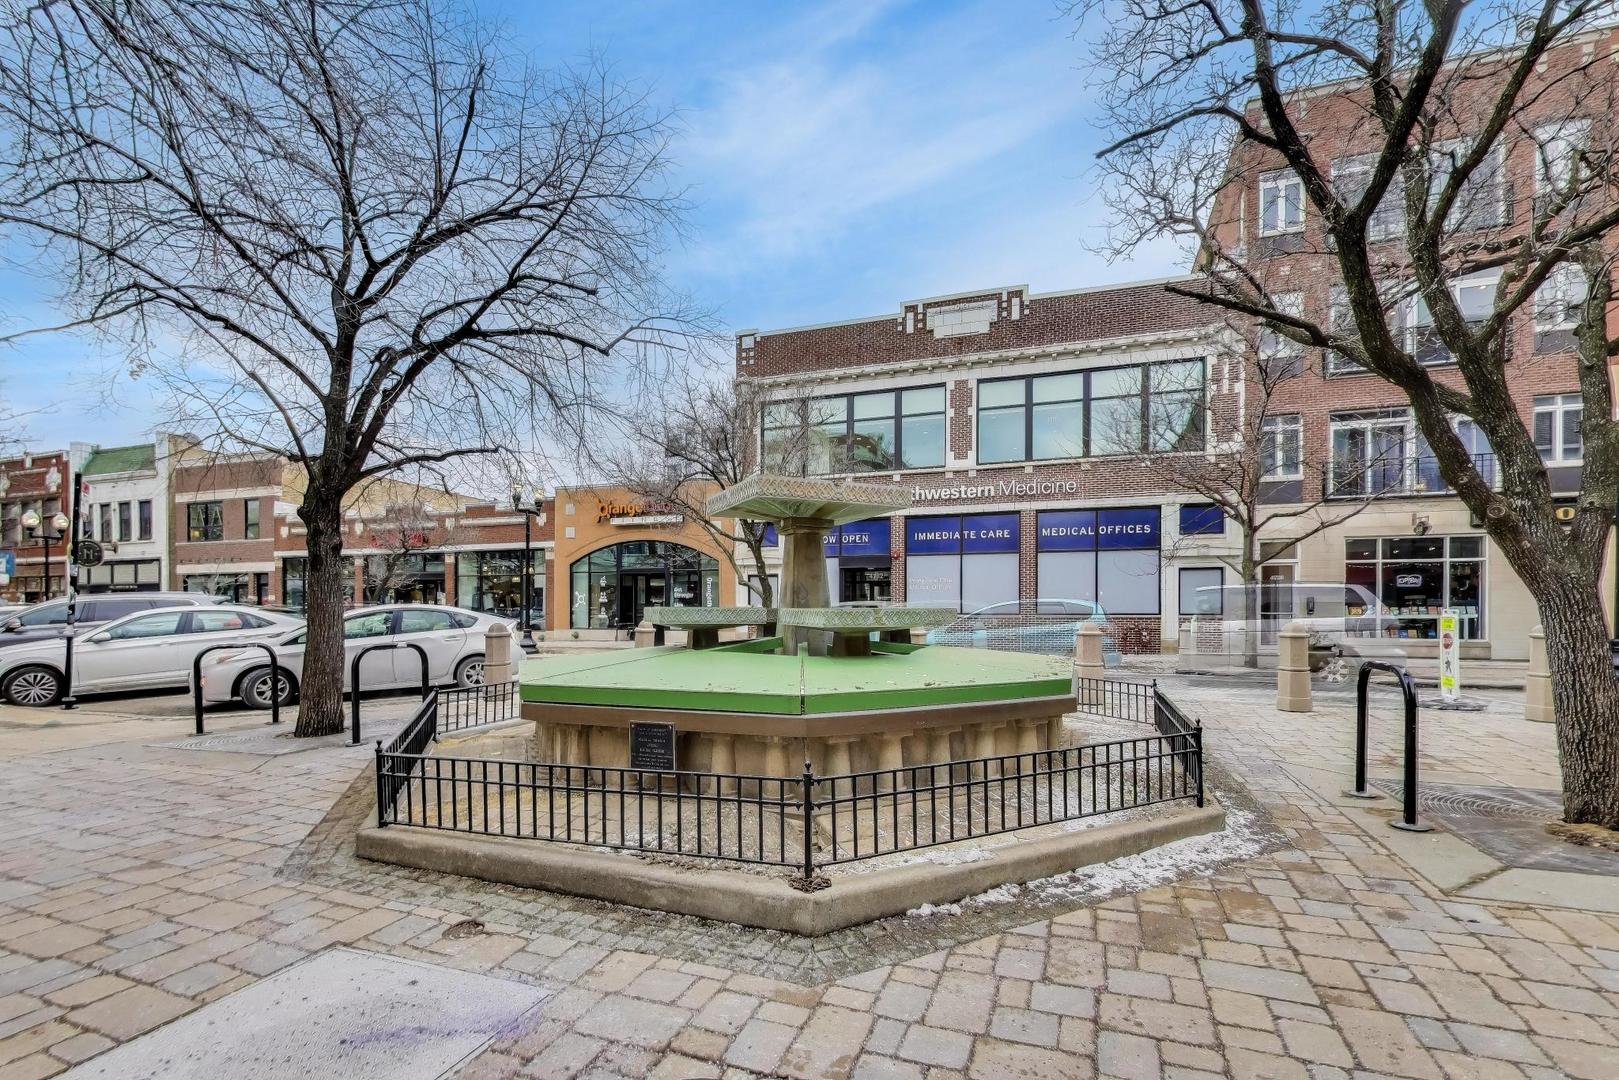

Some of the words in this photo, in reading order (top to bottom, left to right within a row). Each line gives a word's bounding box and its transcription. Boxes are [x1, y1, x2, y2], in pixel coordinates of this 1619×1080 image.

[999, 479, 1077, 496] Medicine
[914, 531, 976, 541] IMMEDIATE
[981, 529, 1010, 539] CARE
[1042, 527, 1094, 537] MEDICAL
[1099, 524, 1151, 534] OFFICES
[822, 535, 837, 544] OW
[841, 534, 869, 543] OPEN
